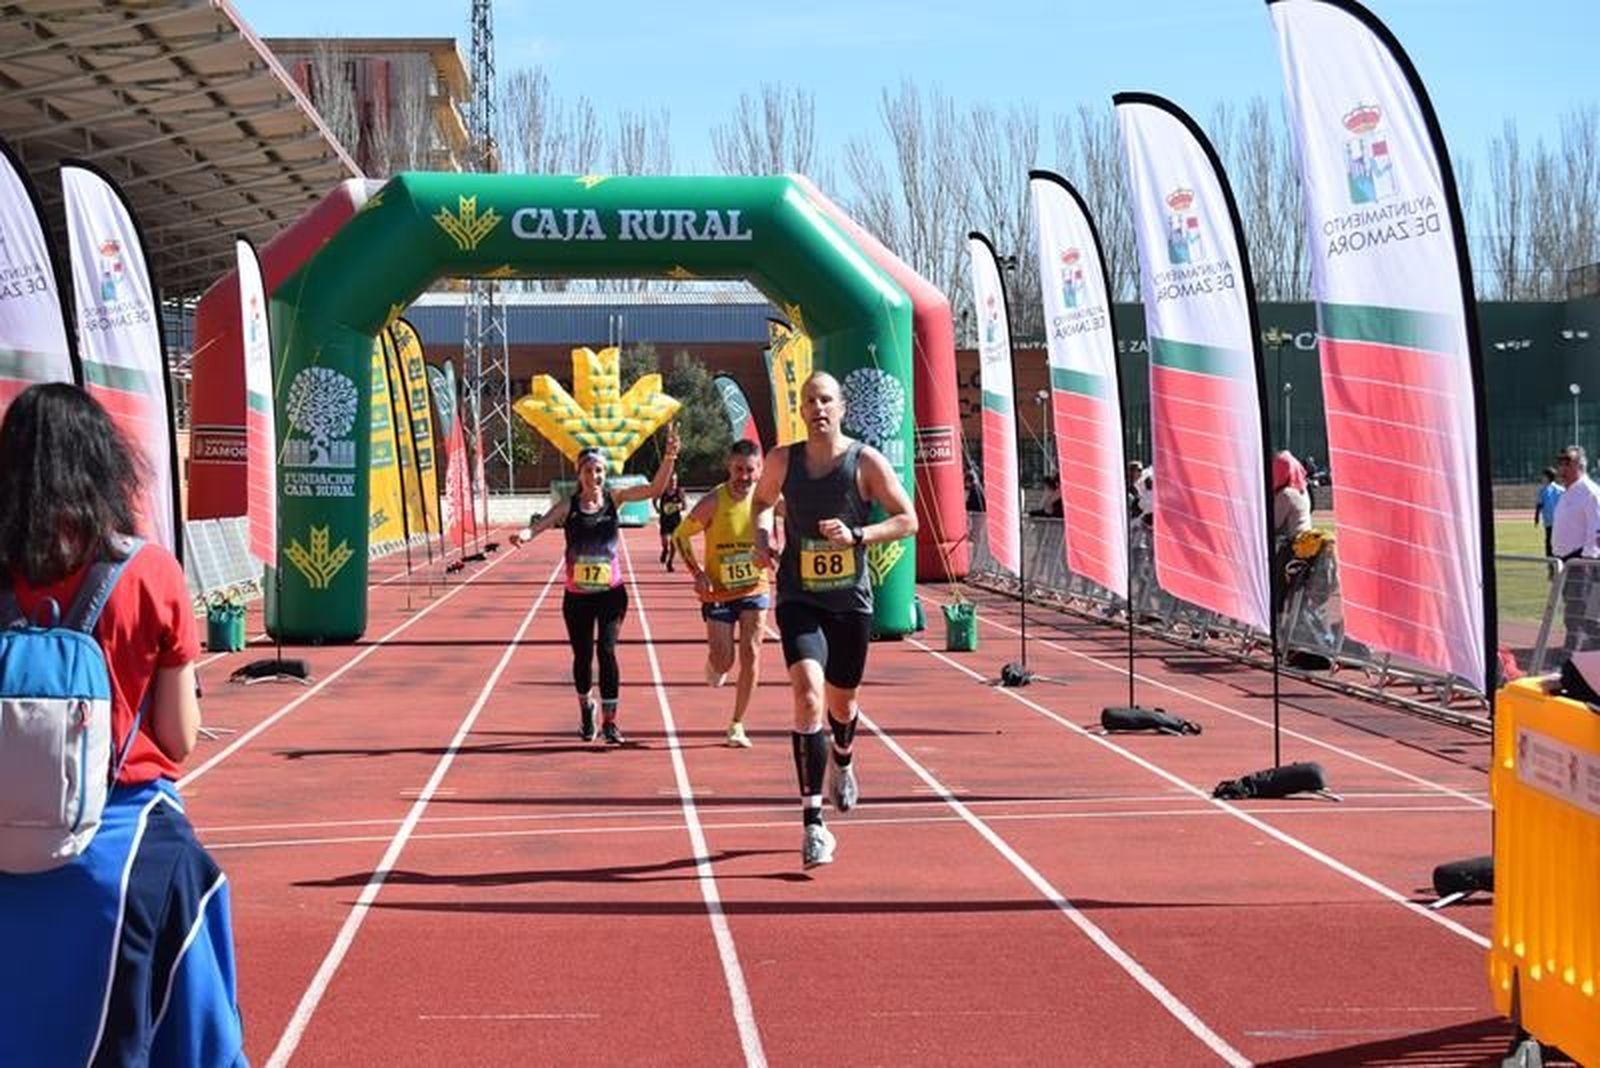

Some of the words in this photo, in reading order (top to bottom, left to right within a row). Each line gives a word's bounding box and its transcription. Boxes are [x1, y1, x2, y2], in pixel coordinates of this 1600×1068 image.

[511, 207, 607, 241] CAJA
[617, 208, 753, 241] RURAL
[1130, 340, 1150, 353] ZA
[205, 445, 247, 457] ZAMOR
[283, 484, 314, 497] CAJA
[315, 484, 356, 497] RURAL
[584, 564, 602, 581] 17
[727, 562, 753, 580] 151
[813, 553, 844, 576] 68
